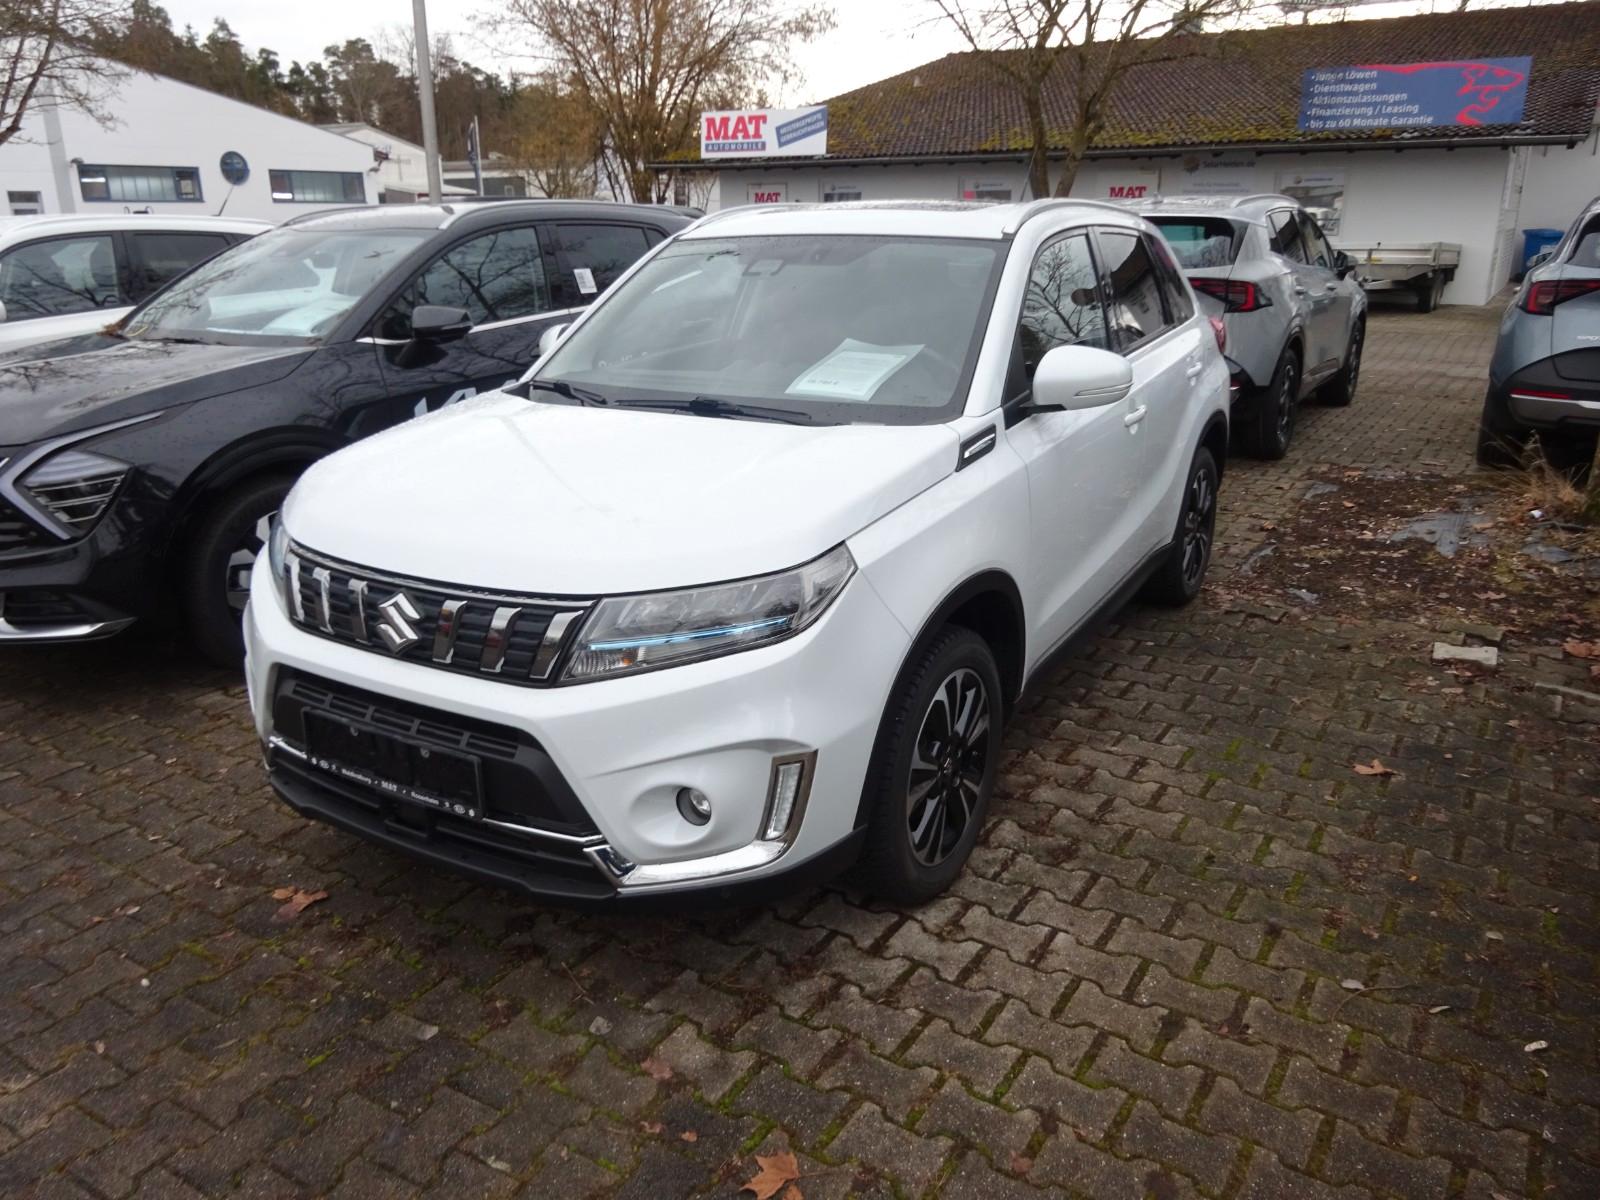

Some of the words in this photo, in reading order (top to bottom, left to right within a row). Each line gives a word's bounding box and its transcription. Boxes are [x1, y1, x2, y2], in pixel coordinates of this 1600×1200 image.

[1315, 72, 1343, 82] Junge
[1345, 70, 1377, 79] Löwen
[1314, 82, 1377, 94] Dienstwagen
[1312, 93, 1408, 105] Aktionszulassungen
[1311, 105, 1373, 116] Finanzierung
[1382, 104, 1419, 115] Leasing
[705, 114, 767, 141] MAT
[1310, 119, 1324, 129] bis
[1325, 120, 1336, 128] zu
[1338, 118, 1351, 127] 60
[1353, 117, 1389, 127] Monate
[1391, 114, 1433, 126] Garantie
[708, 142, 762, 151] AUTOMOBILE
[754, 192, 781, 203] MAT
[1109, 186, 1147, 198] MAT
